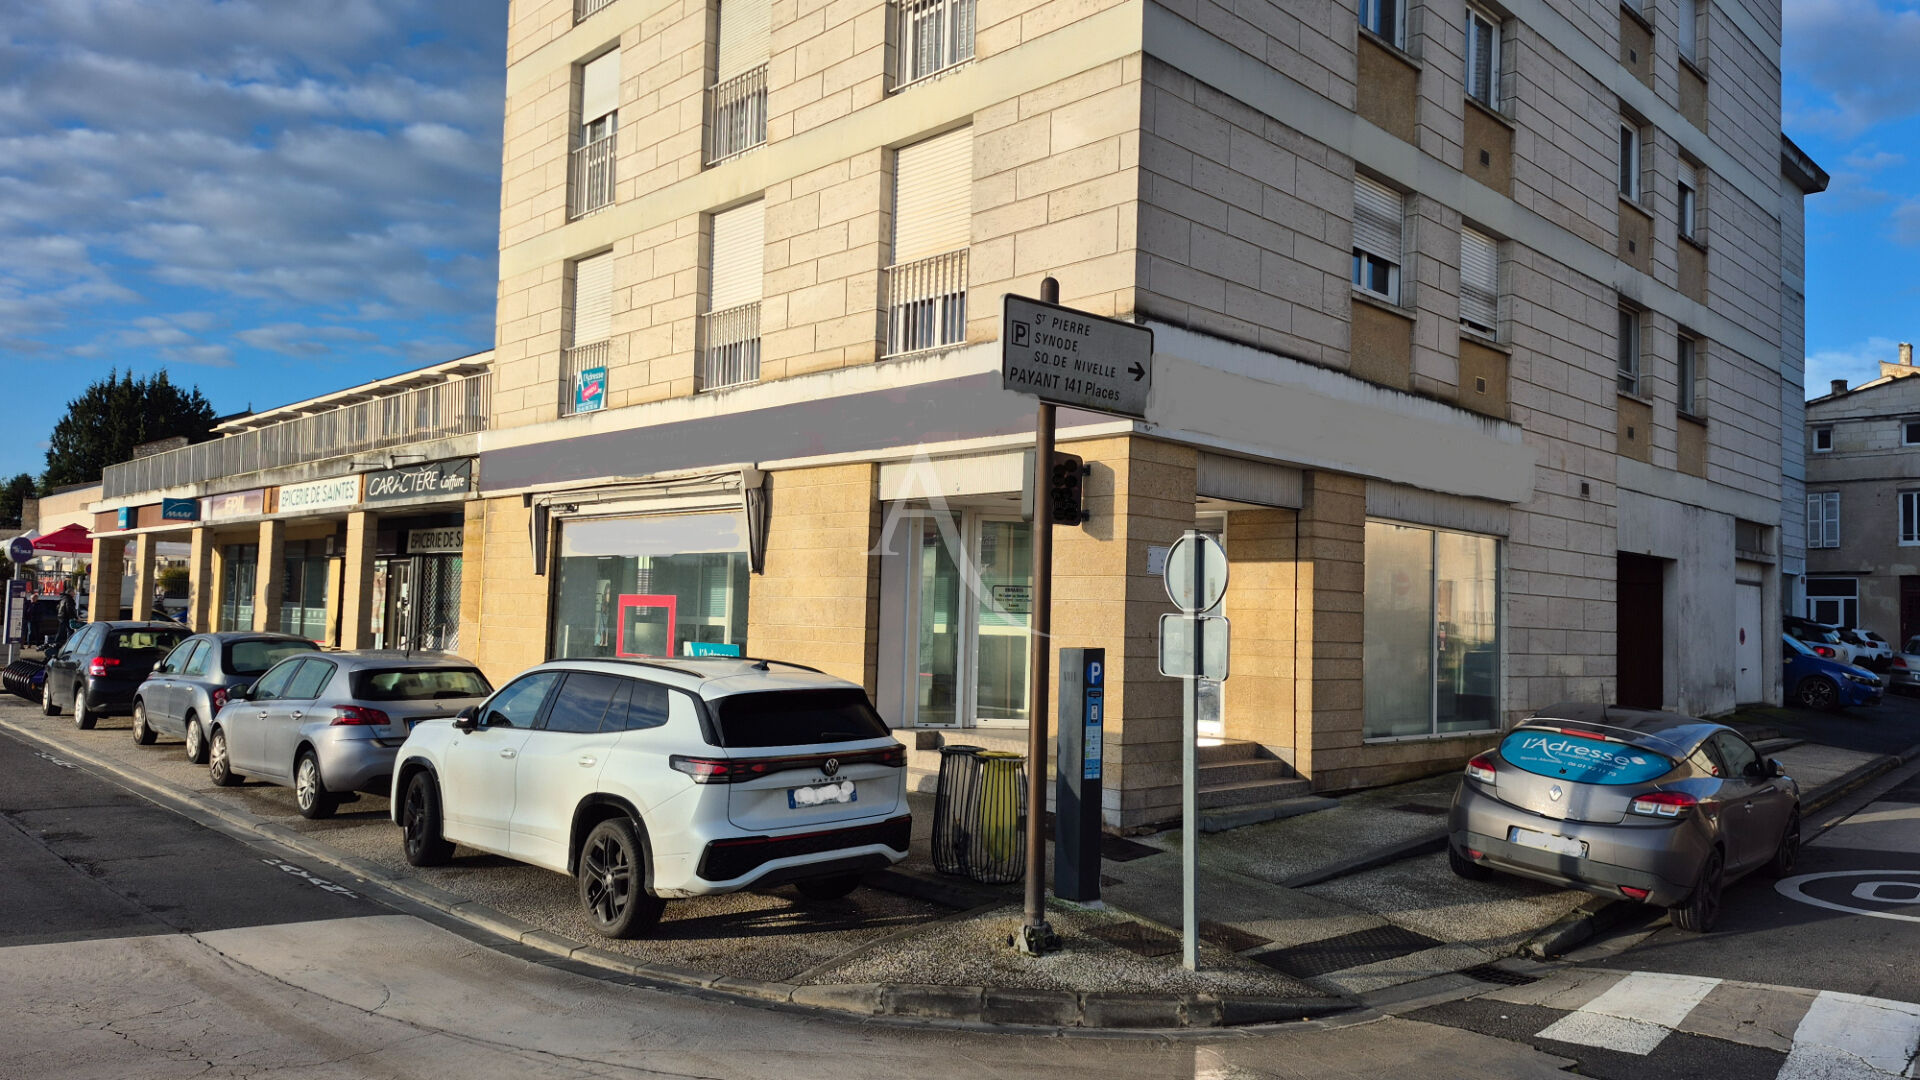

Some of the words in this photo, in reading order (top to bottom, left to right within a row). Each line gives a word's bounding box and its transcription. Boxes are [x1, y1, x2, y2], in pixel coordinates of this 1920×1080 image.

[1015, 324, 1026, 342] P
[1052, 317, 1091, 337] PIERRE
[1034, 332, 1078, 352] SYNODE
[1074, 359, 1116, 378] NIVELLE
[1009, 366, 1060, 389] PAYANT
[1064, 377, 1082, 394] 141
[1085, 381, 1120, 401] Places
[440, 473, 465, 491] Coiffure
[282, 486, 310, 507] EPICERIE
[311, 485, 321, 504] DE
[322, 480, 355, 503] SAINTES
[410, 532, 442, 549] EPICERIE
[443, 531, 454, 548] DE
[1090, 662, 1101, 684] P
[1522, 738, 1631, 766] l'Adresse
